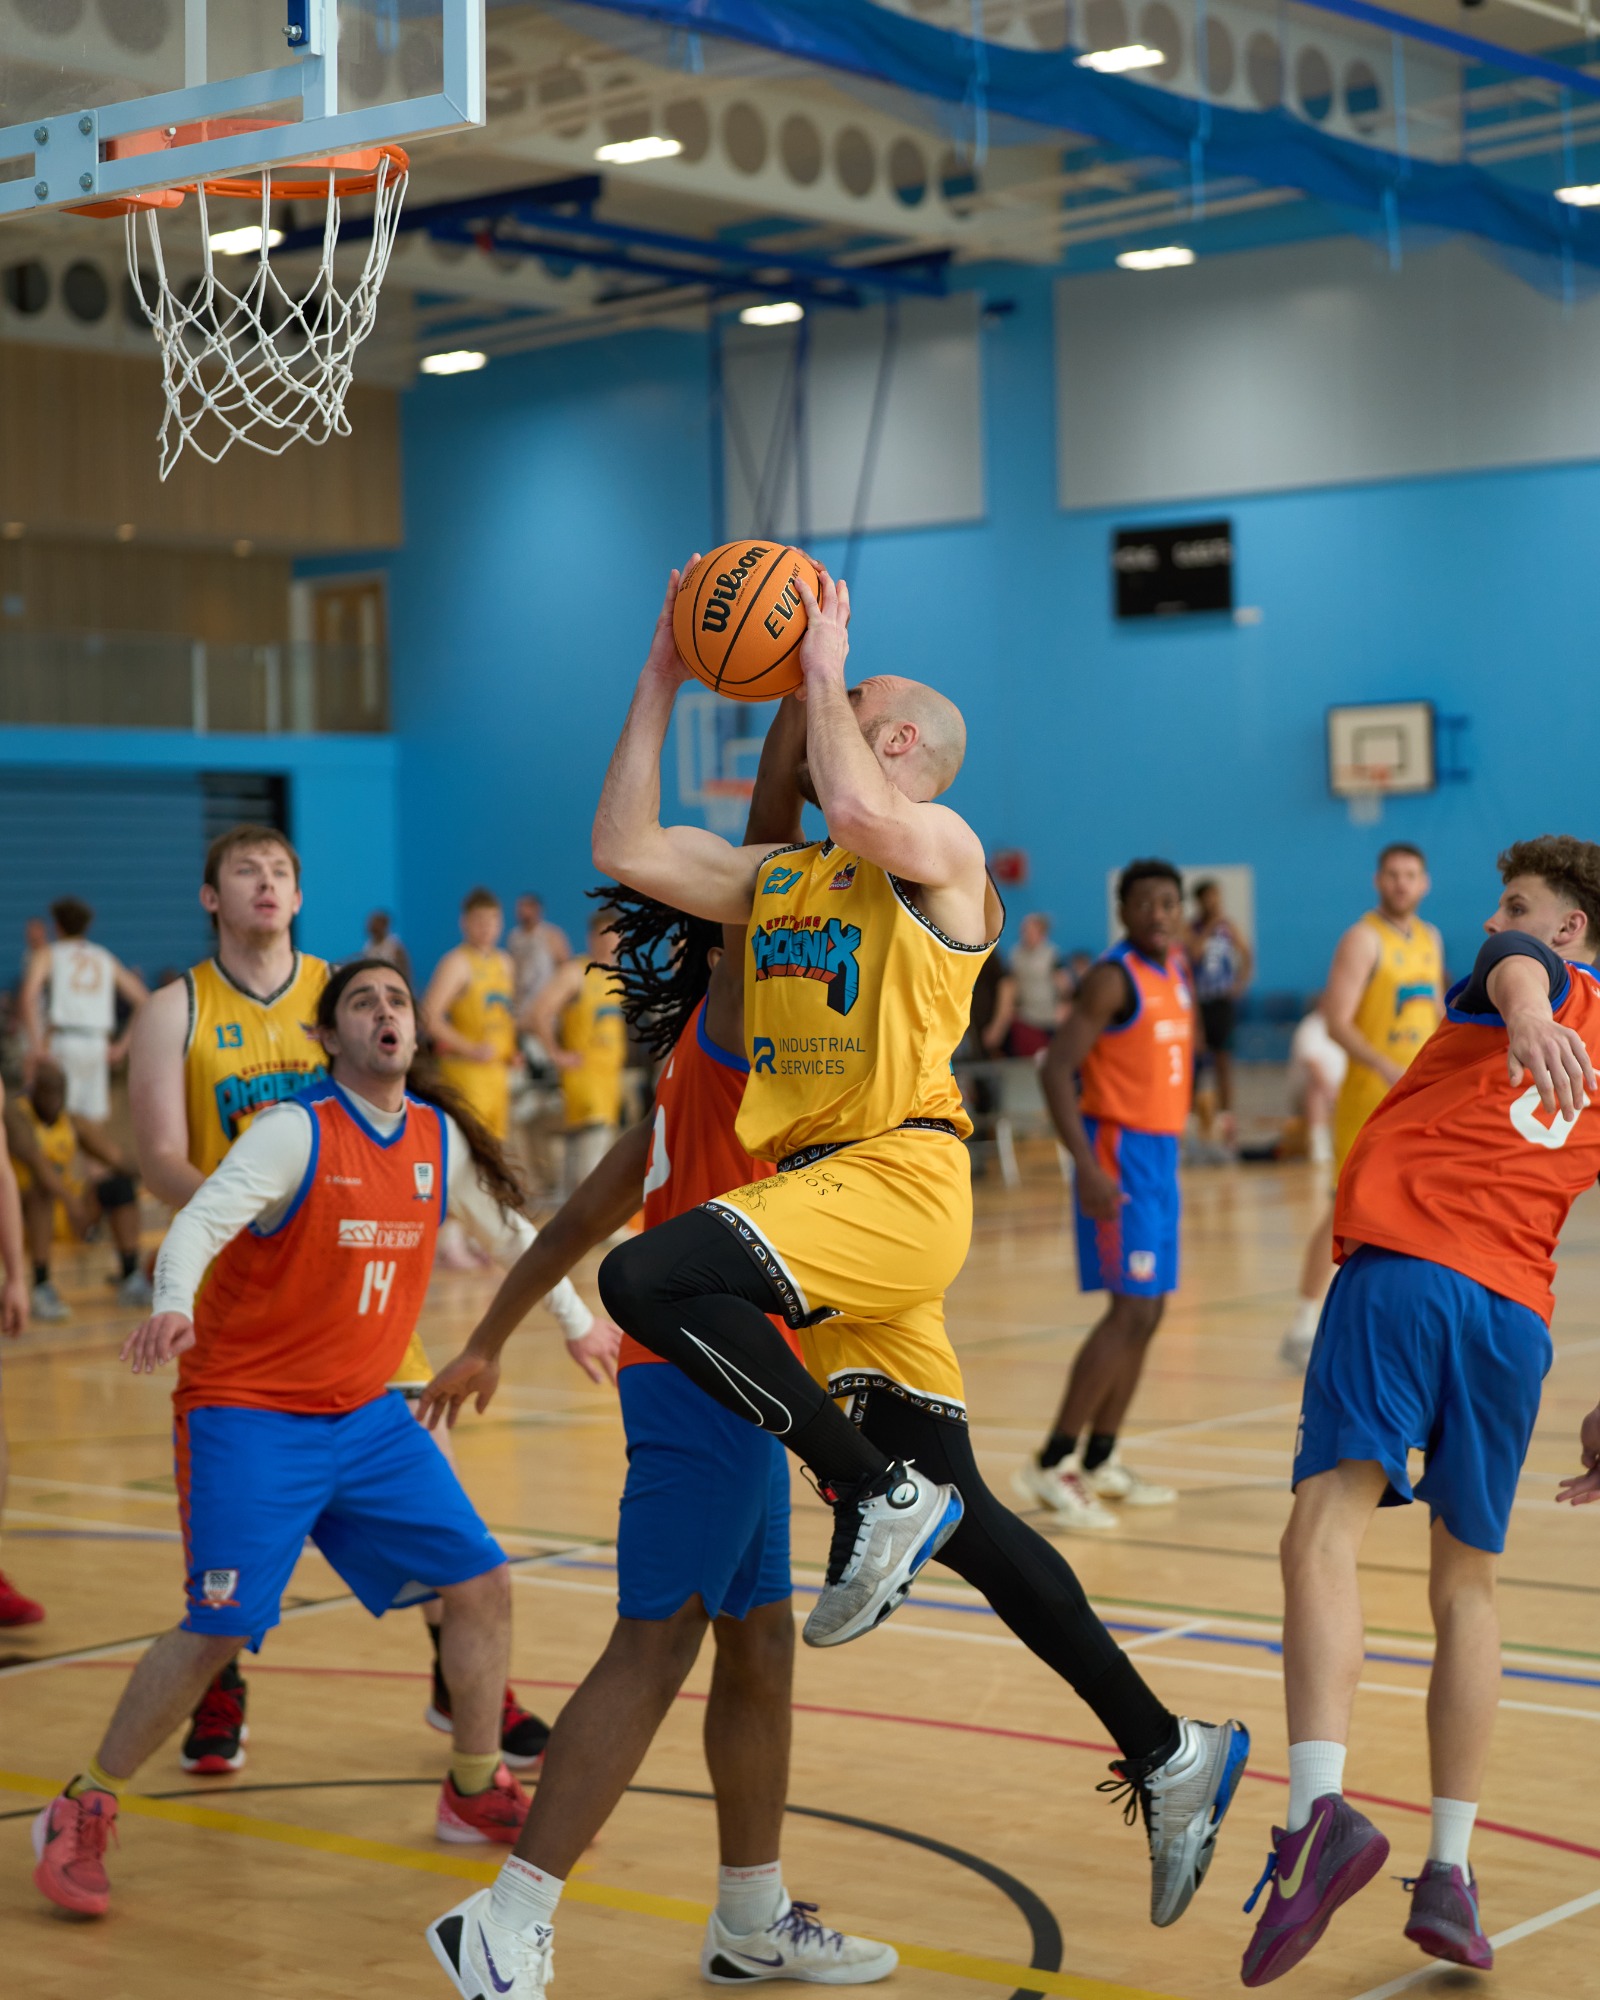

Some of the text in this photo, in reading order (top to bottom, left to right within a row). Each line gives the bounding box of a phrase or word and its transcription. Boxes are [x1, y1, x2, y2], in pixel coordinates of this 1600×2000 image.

[701, 546, 770, 633] Wilson
[762, 867, 804, 895] 21
[215, 1023, 244, 1049] 13
[779, 1037, 866, 1053] INDUSTRIAL
[781, 1060, 845, 1075] SERVICES
[375, 1230, 421, 1248] DERBY
[358, 1261, 397, 1316] 14
